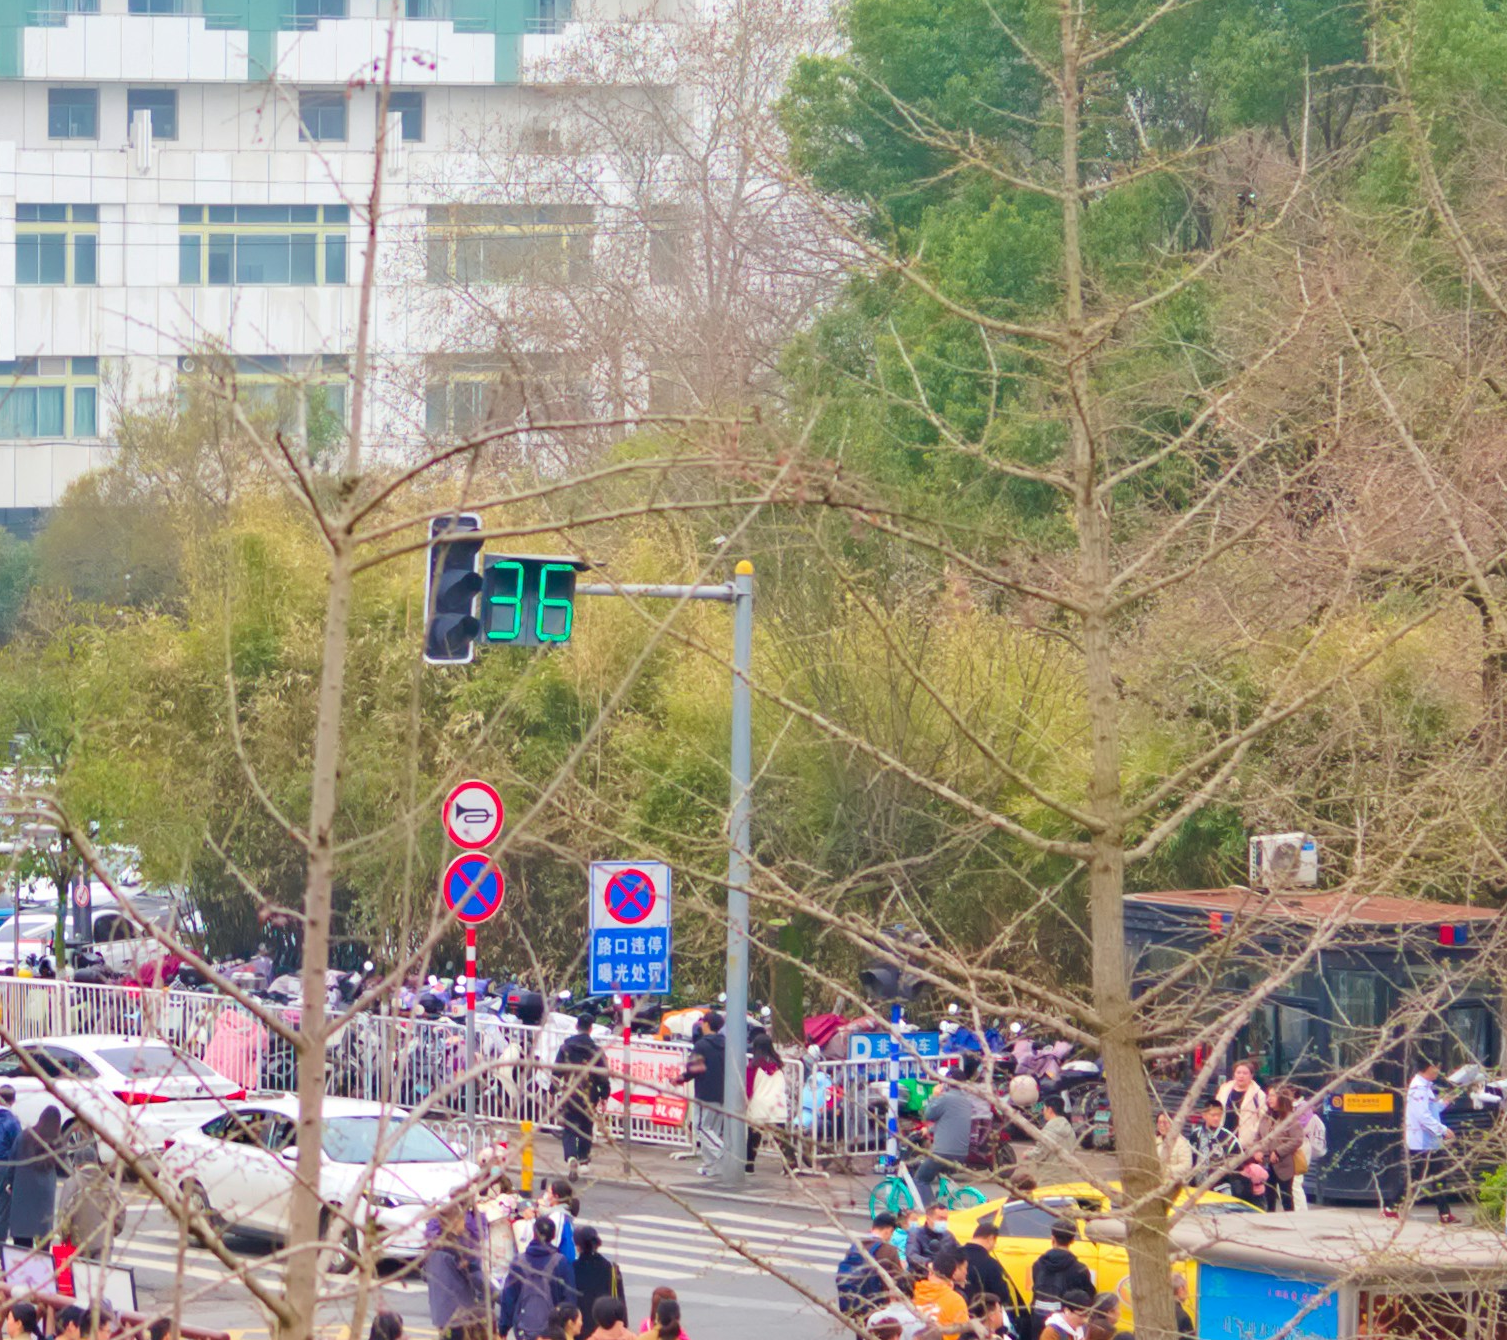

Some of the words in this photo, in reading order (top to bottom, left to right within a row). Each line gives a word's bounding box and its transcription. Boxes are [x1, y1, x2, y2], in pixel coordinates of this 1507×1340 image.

[488, 561, 574, 642] 36
[597, 936, 663, 955] 路口违停
[598, 962, 663, 983] 曝光处罚
